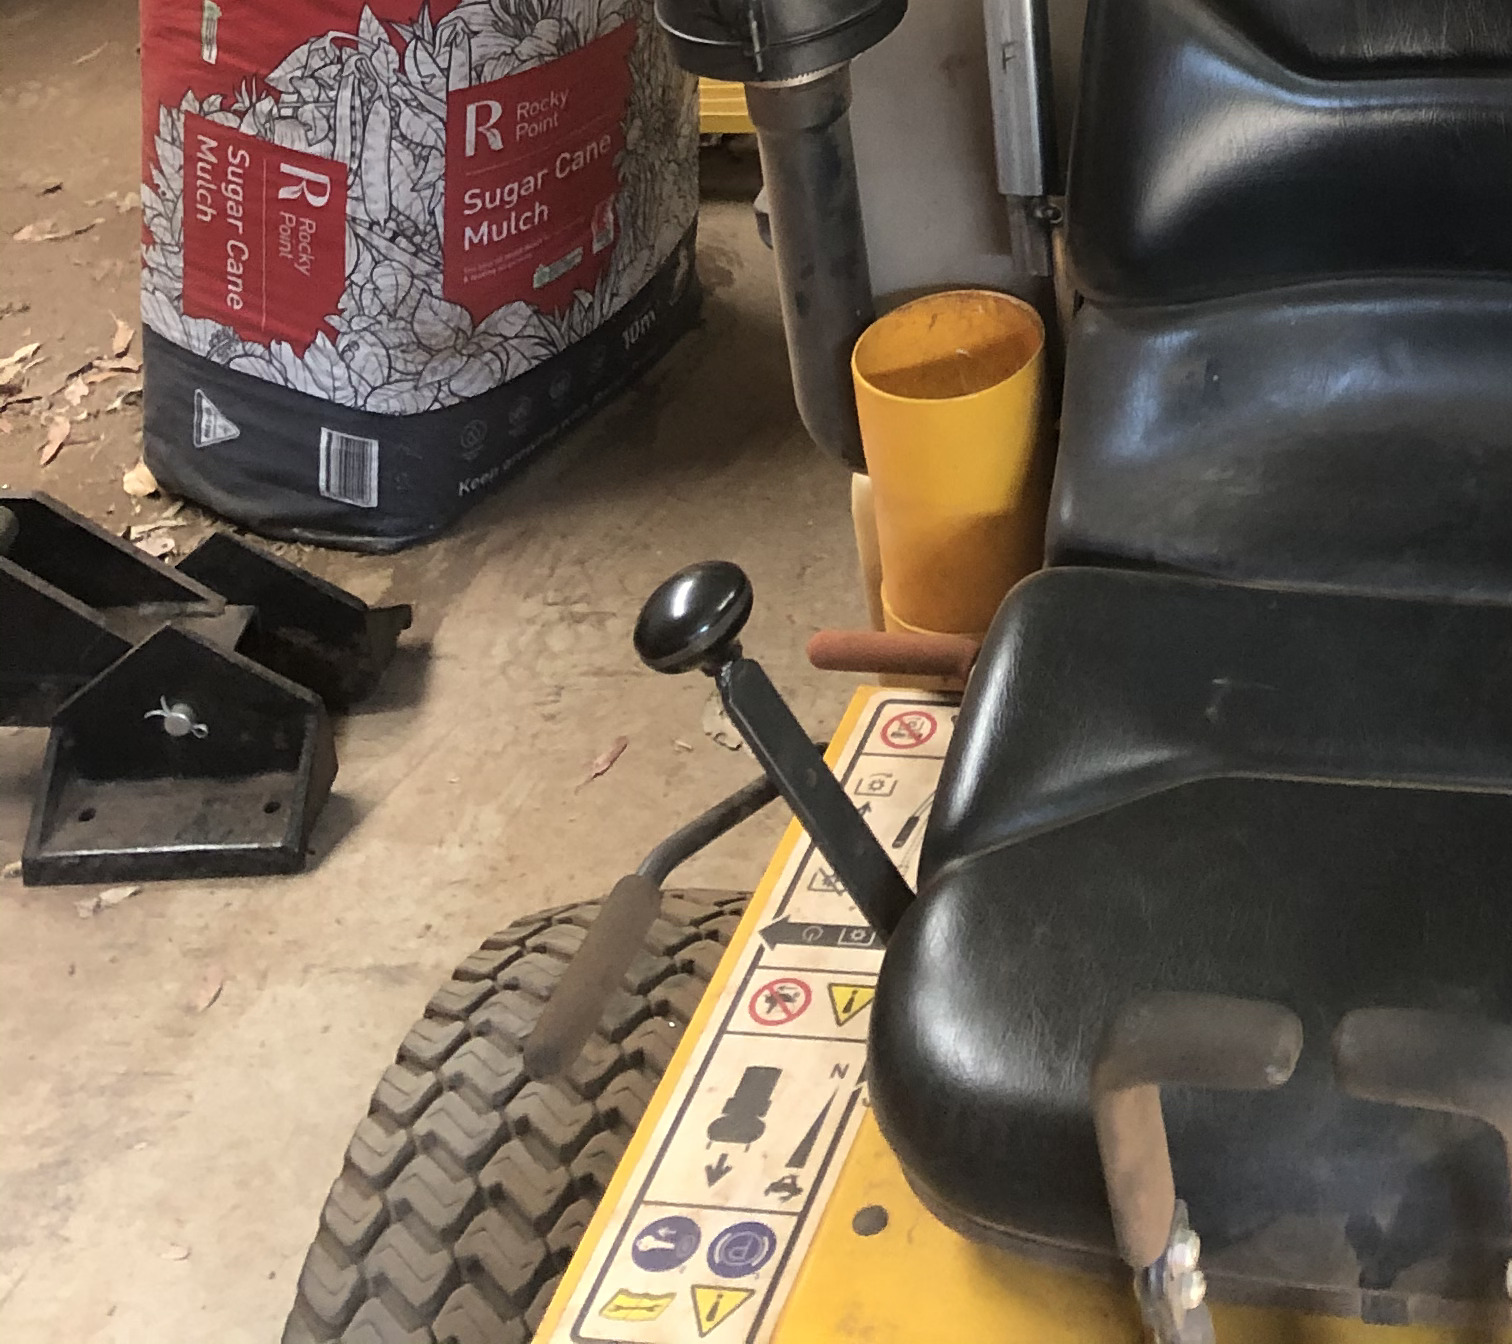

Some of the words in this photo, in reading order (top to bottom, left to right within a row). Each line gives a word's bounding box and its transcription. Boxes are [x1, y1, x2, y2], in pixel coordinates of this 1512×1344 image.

[465, 99, 503, 157] R
[517, 88, 570, 121] Rocky
[515, 113, 559, 142] Point
[196, 134, 218, 223] Mulch
[221, 145, 250, 235] Sugar
[463, 167, 549, 215] Sugar
[555, 134, 612, 179] Cane
[278, 211, 296, 259] Point
[294, 217, 316, 277] Rocky
[463, 201, 549, 251] Mulch
[226, 239, 249, 311] Cane
